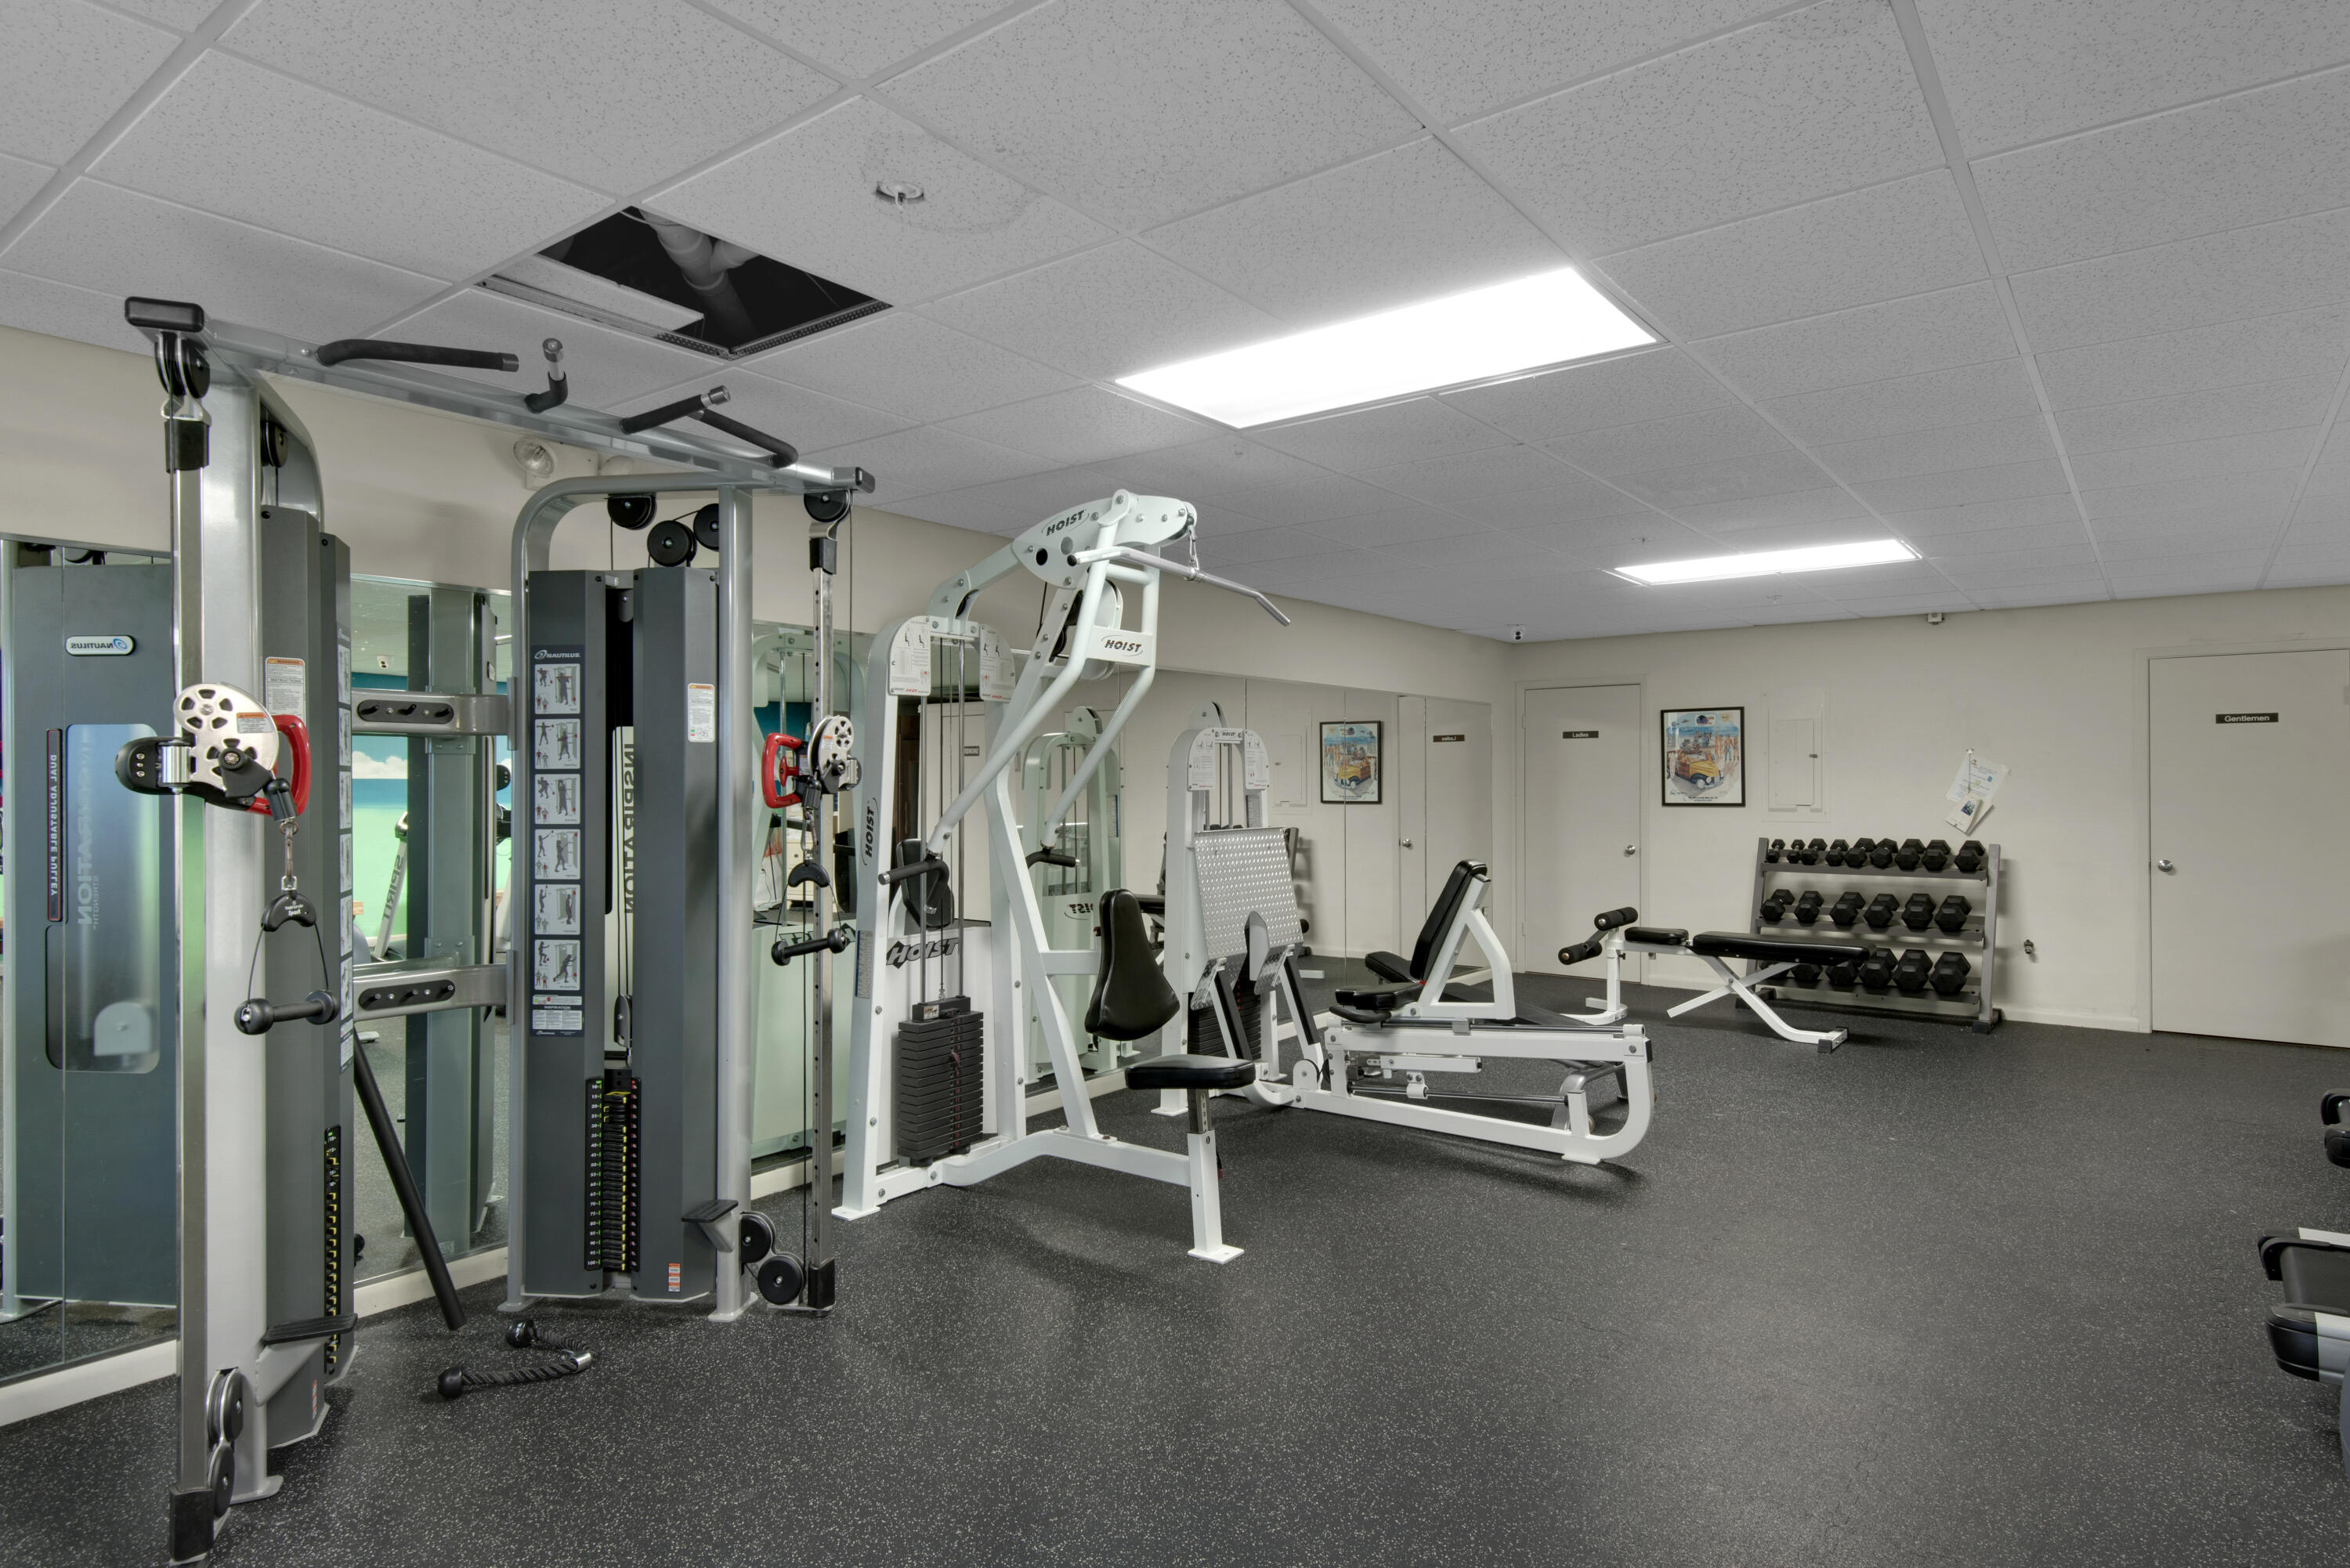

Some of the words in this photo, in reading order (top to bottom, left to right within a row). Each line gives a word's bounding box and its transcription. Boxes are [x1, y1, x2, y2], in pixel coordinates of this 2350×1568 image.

[1047, 509, 1085, 536] HOIST
[1104, 639, 1141, 652] HOIST
[865, 805, 875, 858] HOIST
[886, 937, 959, 966] HOIST
